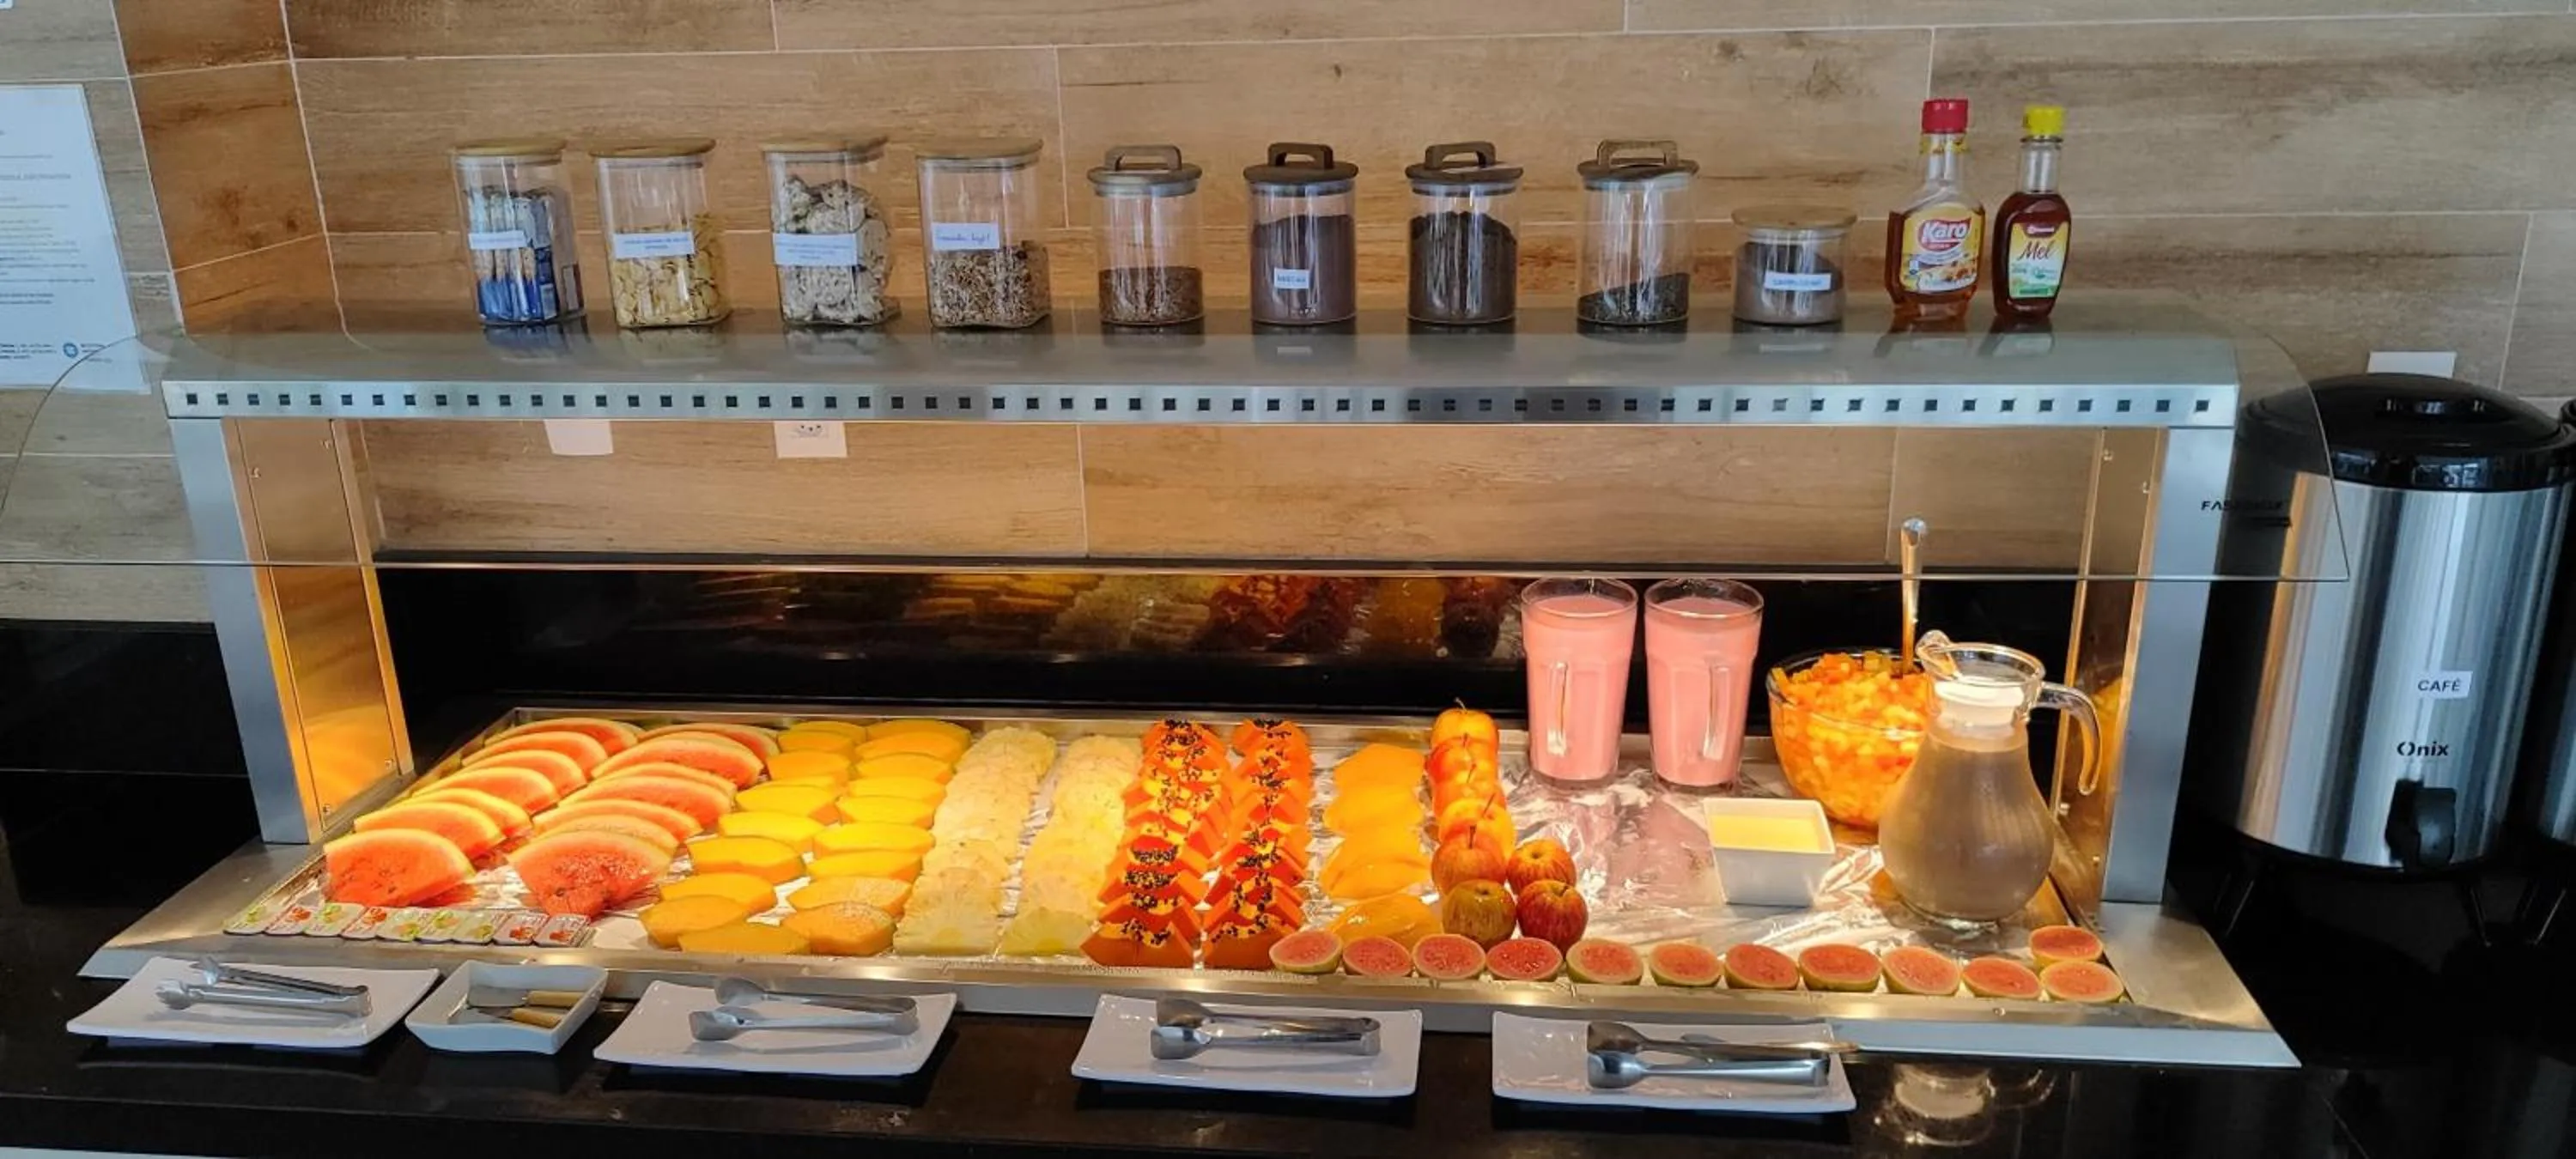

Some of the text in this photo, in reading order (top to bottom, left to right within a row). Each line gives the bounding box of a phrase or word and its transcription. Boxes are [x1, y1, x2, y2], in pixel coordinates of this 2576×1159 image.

[1922, 221, 1968, 244] Karo
[2016, 240, 2056, 261] Mel
[2417, 677, 2462, 693] CAFÉ
[2397, 740, 2450, 757] Onix
